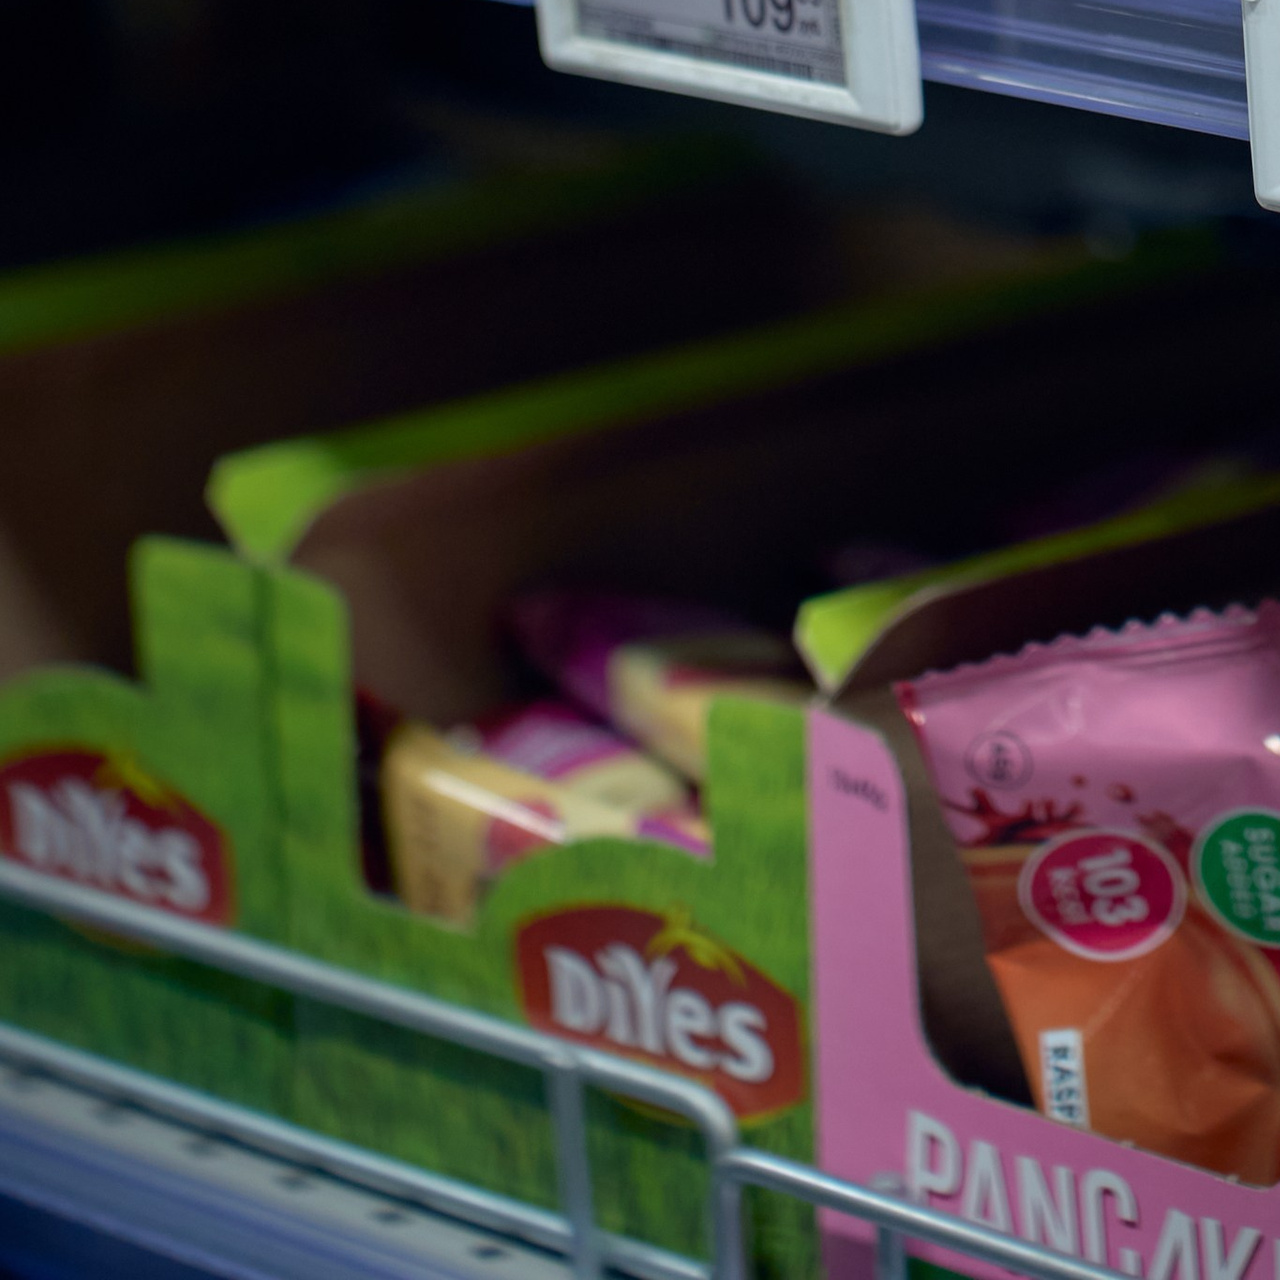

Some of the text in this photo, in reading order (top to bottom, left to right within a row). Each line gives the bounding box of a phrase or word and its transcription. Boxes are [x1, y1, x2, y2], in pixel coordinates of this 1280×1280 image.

[1076, 845, 1150, 928] 103
[542, 943, 775, 1085] DiYes
[1050, 1044, 1078, 1120] RASP
